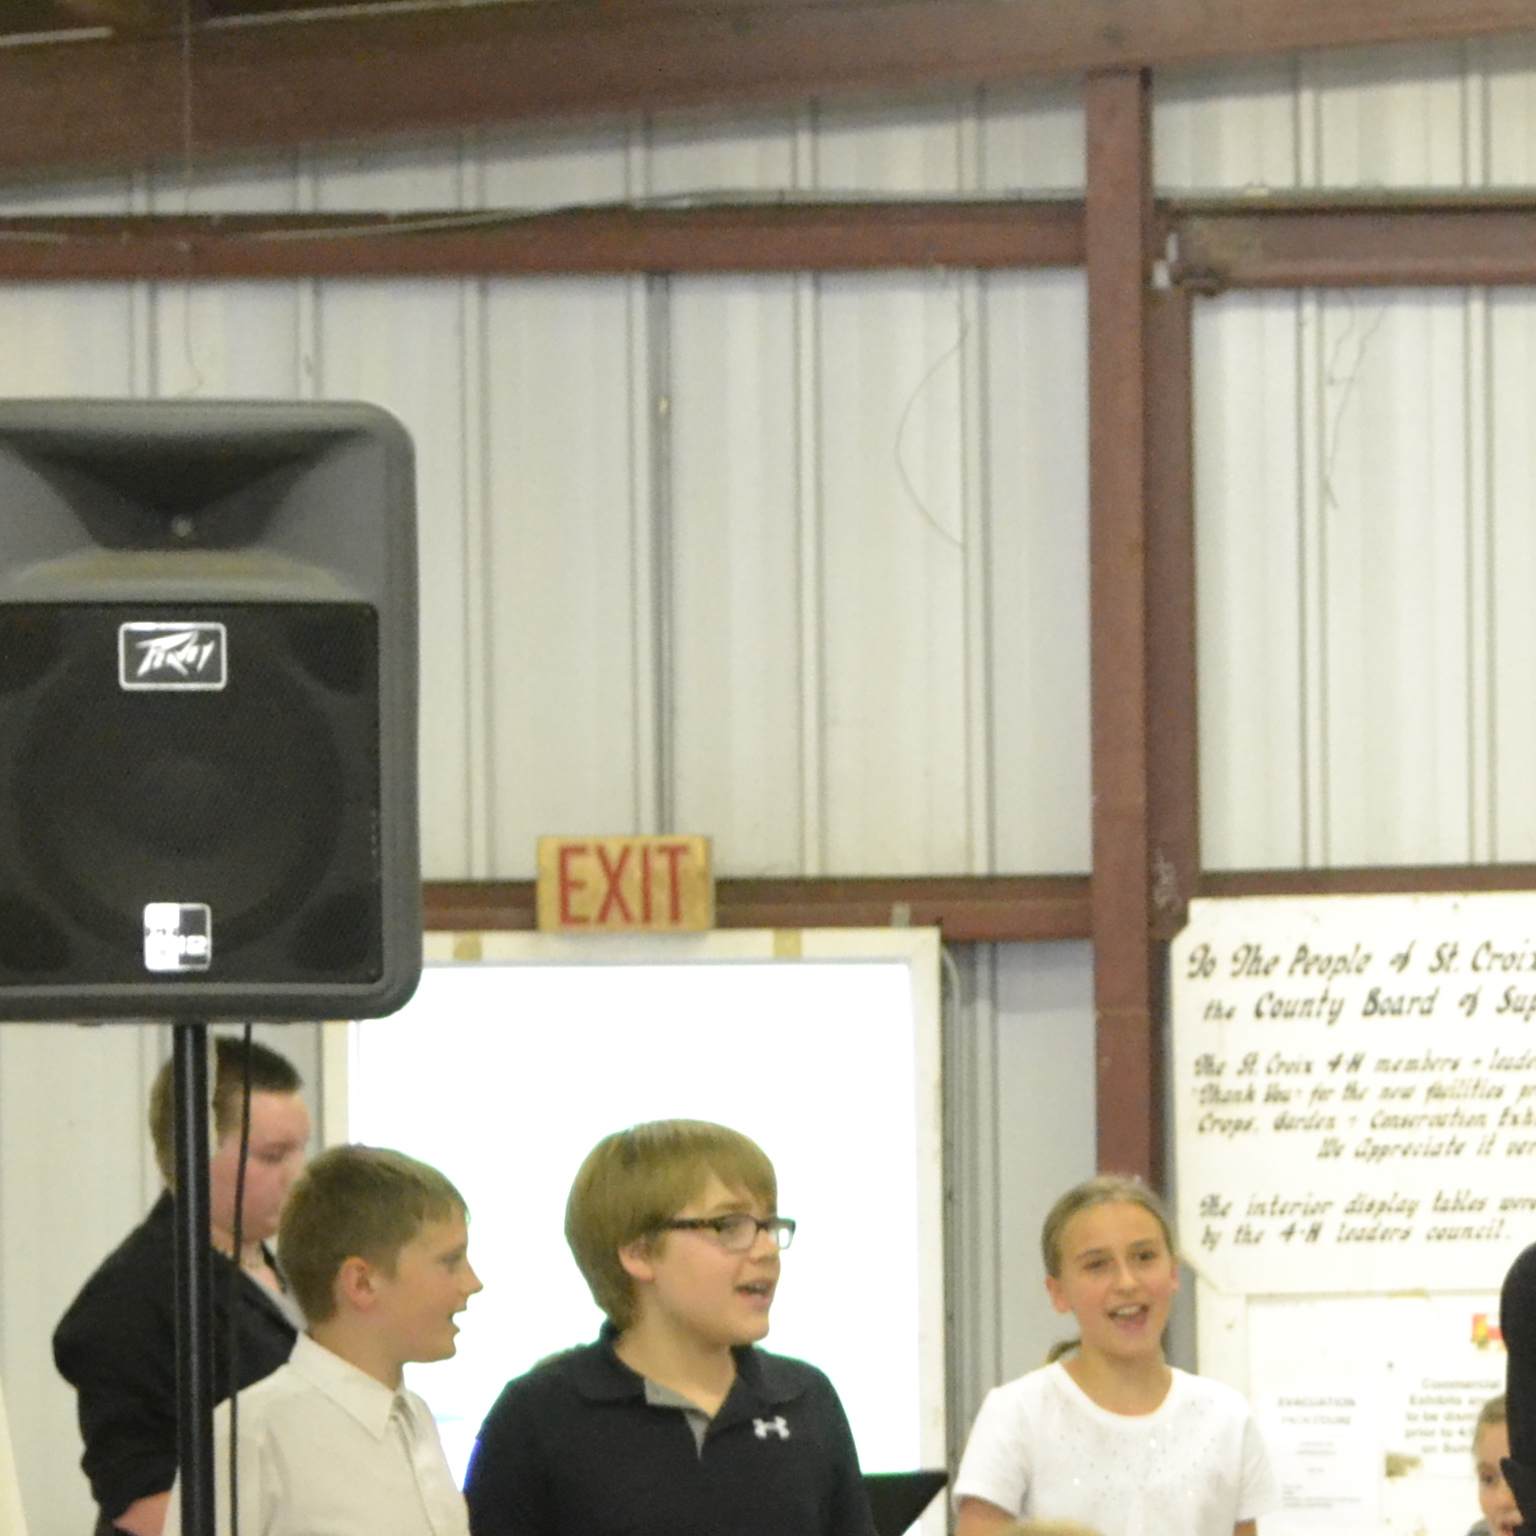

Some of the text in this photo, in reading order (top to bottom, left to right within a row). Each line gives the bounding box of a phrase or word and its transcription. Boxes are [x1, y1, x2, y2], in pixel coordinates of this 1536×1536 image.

[559, 844, 690, 925] EXIT
[1187, 942, 1218, 979] To
[1230, 942, 1280, 978] The
[1288, 942, 1373, 982] People
[1389, 938, 1416, 974] of
[1203, 998, 1236, 1022] the
[1254, 986, 1345, 1028] County
[1361, 985, 1440, 1017] Board
[1458, 984, 1482, 1018] of
[1194, 1053, 1227, 1077] The
[1266, 1052, 1313, 1076] Croix
[1374, 1047, 1461, 1073] members
[1308, 1082, 1336, 1107] for
[1342, 1080, 1370, 1102] the
[1378, 1085, 1416, 1101] new
[1424, 1077, 1505, 1105] facilities
[1273, 1110, 1336, 1131] Garden
[1369, 1106, 1488, 1130] Conservation
[1317, 1136, 1346, 1160] We
[1476, 1131, 1497, 1156] it
[1199, 1193, 1233, 1218] The
[1246, 1191, 1335, 1217] interior
[1344, 1190, 1420, 1219] display
[1432, 1189, 1488, 1213] tables
[1201, 1223, 1222, 1252] by
[1233, 1222, 1265, 1245] the
[1336, 1221, 1413, 1243] leaders
